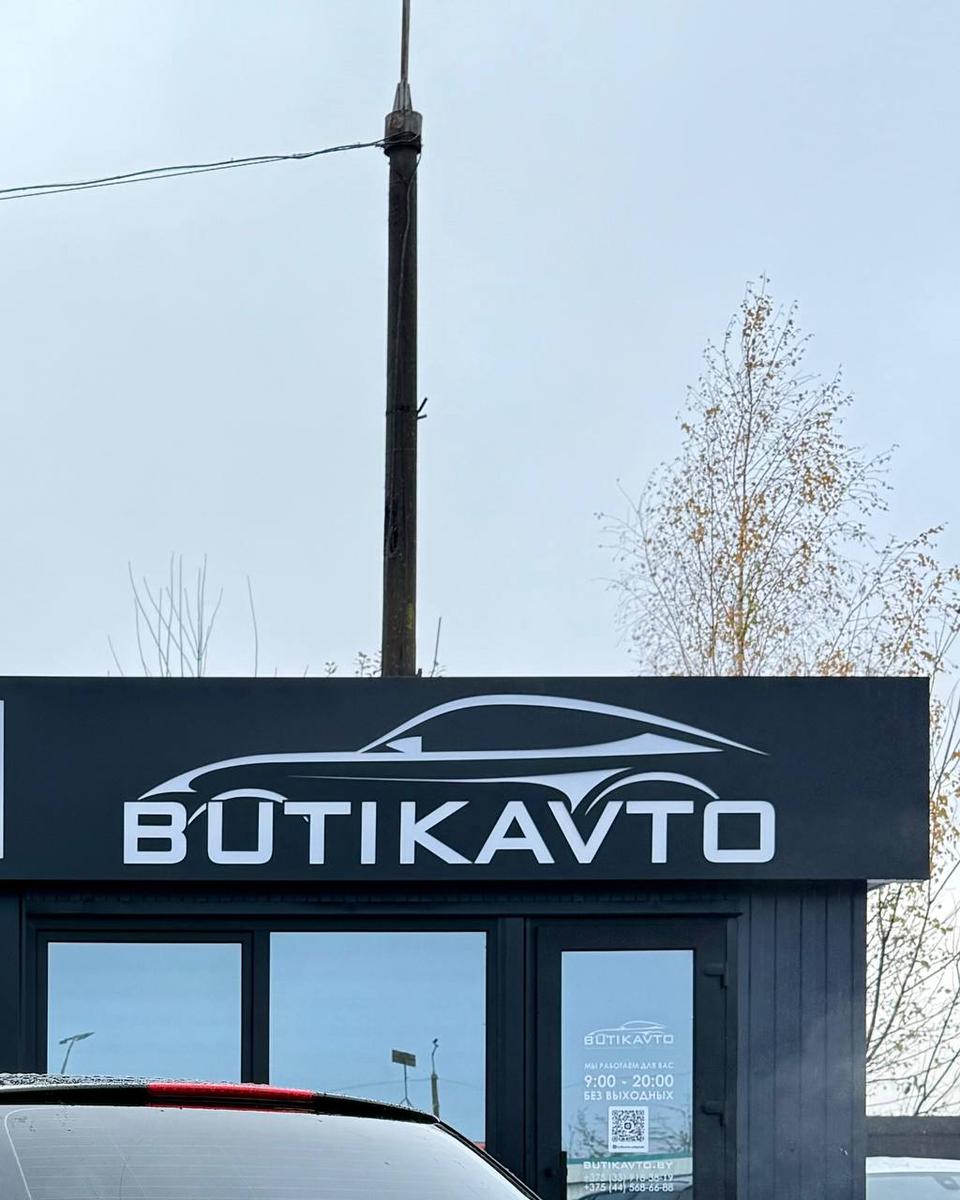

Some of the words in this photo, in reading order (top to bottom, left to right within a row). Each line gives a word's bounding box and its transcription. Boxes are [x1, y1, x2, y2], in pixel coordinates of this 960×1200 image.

[122, 799, 776, 865] BUTIKAVTO
[583, 1034, 675, 1046] BUTIKAVTO
[584, 1074, 617, 1089] 9:00
[632, 1074, 674, 1088] 20:00
[583, 1090, 602, 1101] БЕЗ
[606, 1090, 675, 1102] ВЫХОДНЫХ
[628, 1182, 675, 1192] 568-66-88
